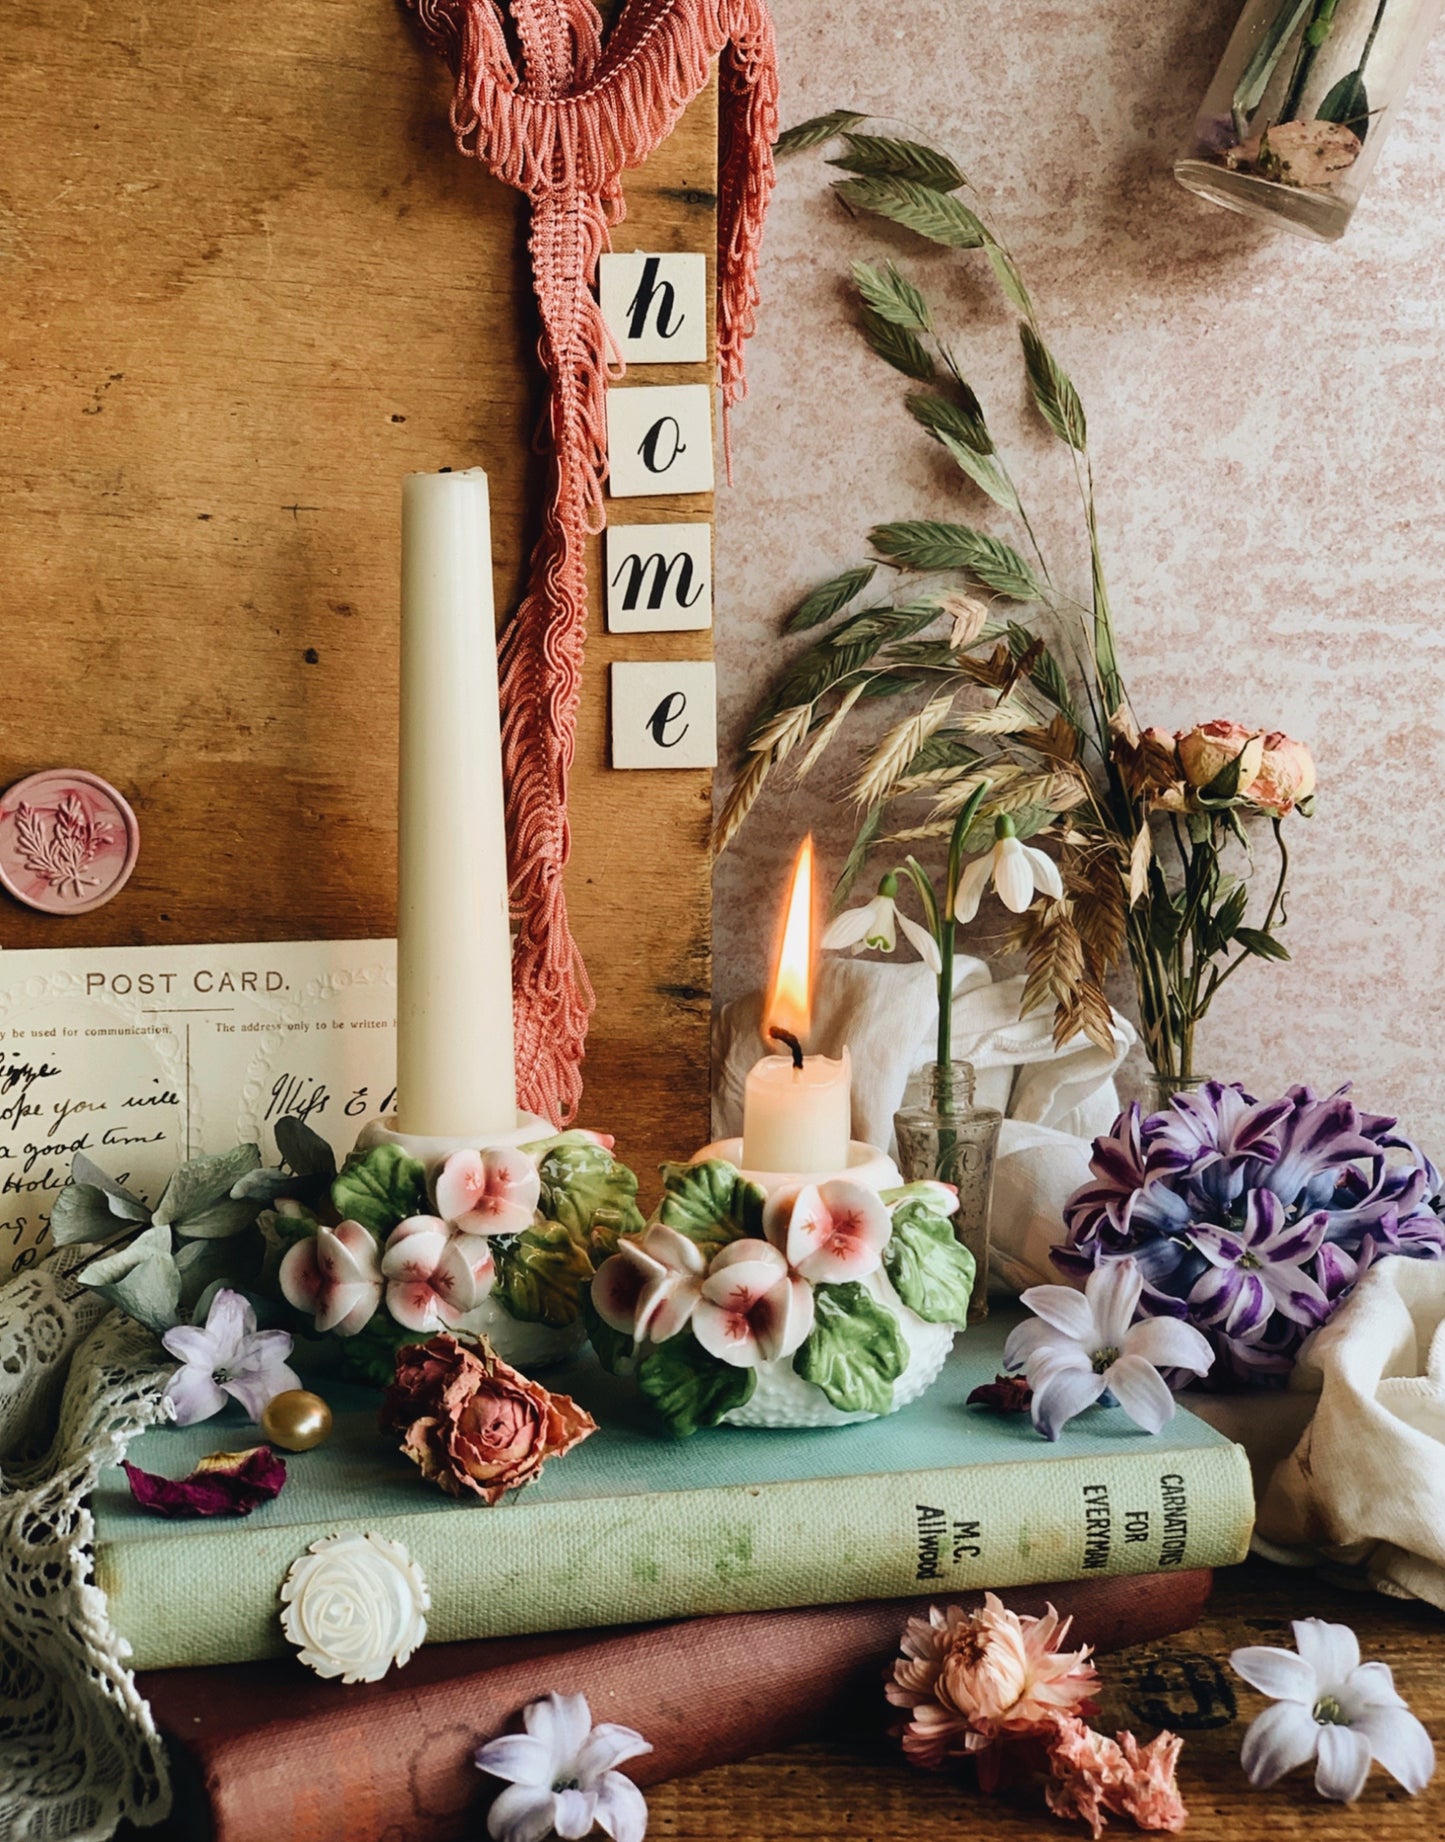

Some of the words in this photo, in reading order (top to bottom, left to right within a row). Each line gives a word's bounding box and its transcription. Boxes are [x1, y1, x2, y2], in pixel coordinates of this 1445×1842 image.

[85, 972, 178, 996] POST
[193, 970, 290, 994] CARD.
[12, 1028, 26, 1039] be
[30, 1027, 57, 1038] used
[62, 1026, 79, 1037] for
[84, 1024, 173, 1037] communication.
[215, 1022, 236, 1033] The
[240, 1021, 282, 1032] address
[286, 1020, 310, 1033] only
[315, 1021, 328, 1031] to
[331, 1019, 345, 1030] be
[349, 1019, 388, 1029] written
[0, 1093, 44, 1131] ope
[48, 1099, 107, 1138] you
[121, 1078, 181, 1108] will
[23, 1132, 94, 1174] good
[102, 1126, 167, 1146] time
[914, 1503, 946, 1581] Allwood
[952, 1520, 982, 1565] M.C.
[1081, 1484, 1112, 1569] EVERYMAN
[1124, 1510, 1150, 1544] FOR
[1159, 1473, 1189, 1567] CARNATIONS
